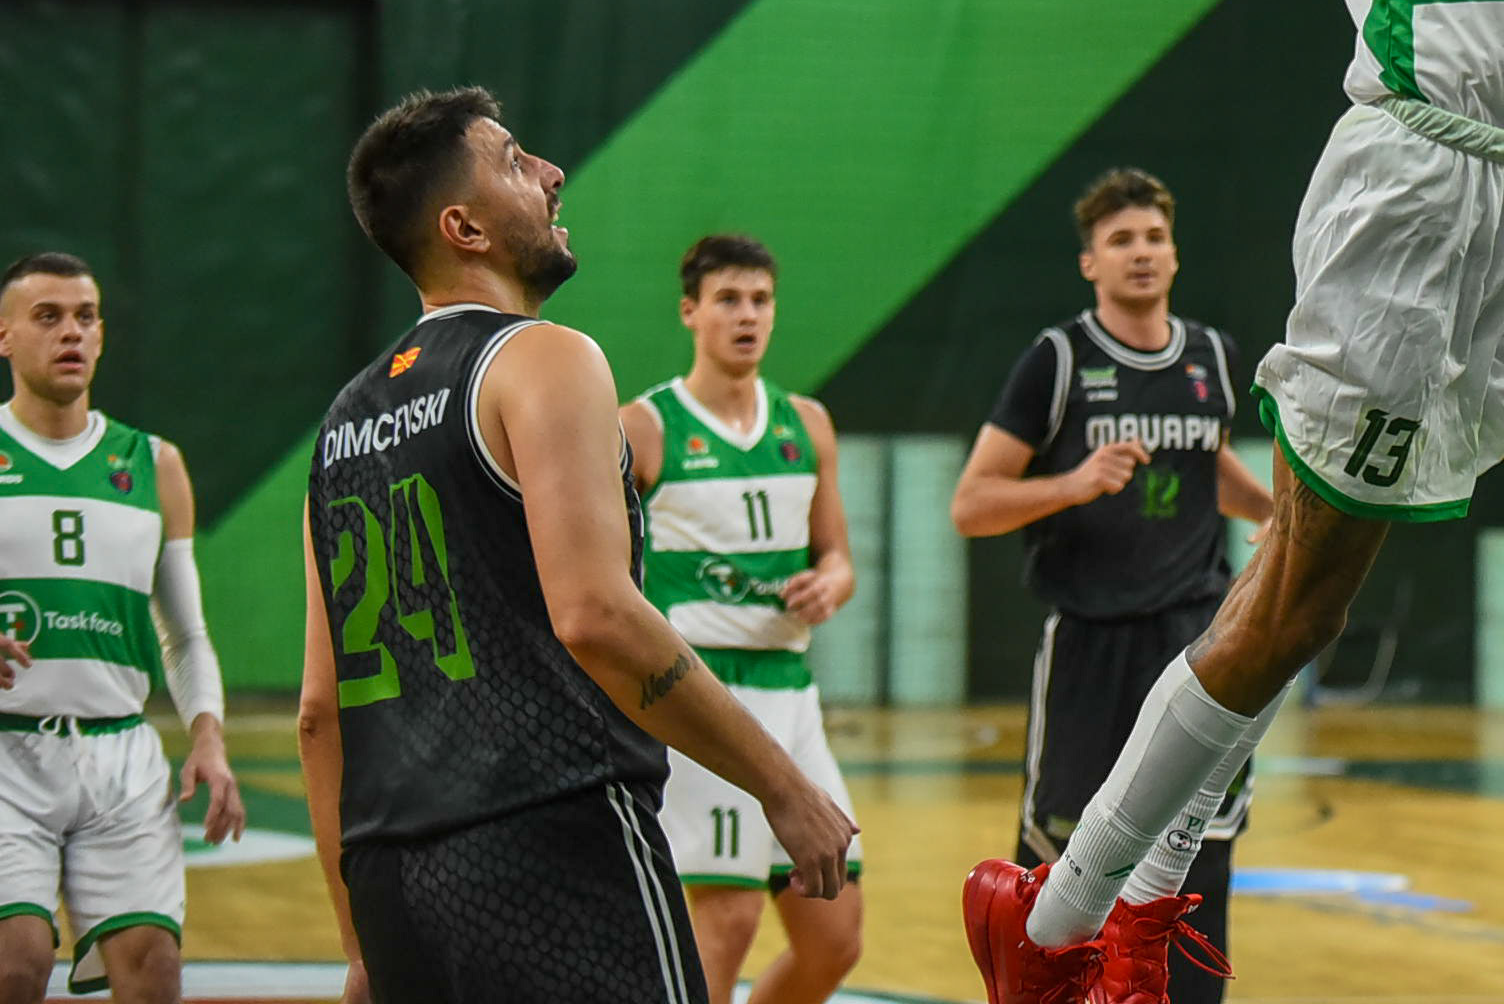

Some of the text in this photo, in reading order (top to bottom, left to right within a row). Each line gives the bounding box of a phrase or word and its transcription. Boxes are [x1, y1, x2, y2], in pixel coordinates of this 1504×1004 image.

[1344, 408, 1422, 488] 13
[53, 510, 85, 567] 8
[742, 490, 773, 539] 11
[327, 473, 477, 708] 24
[711, 807, 739, 858] 11
